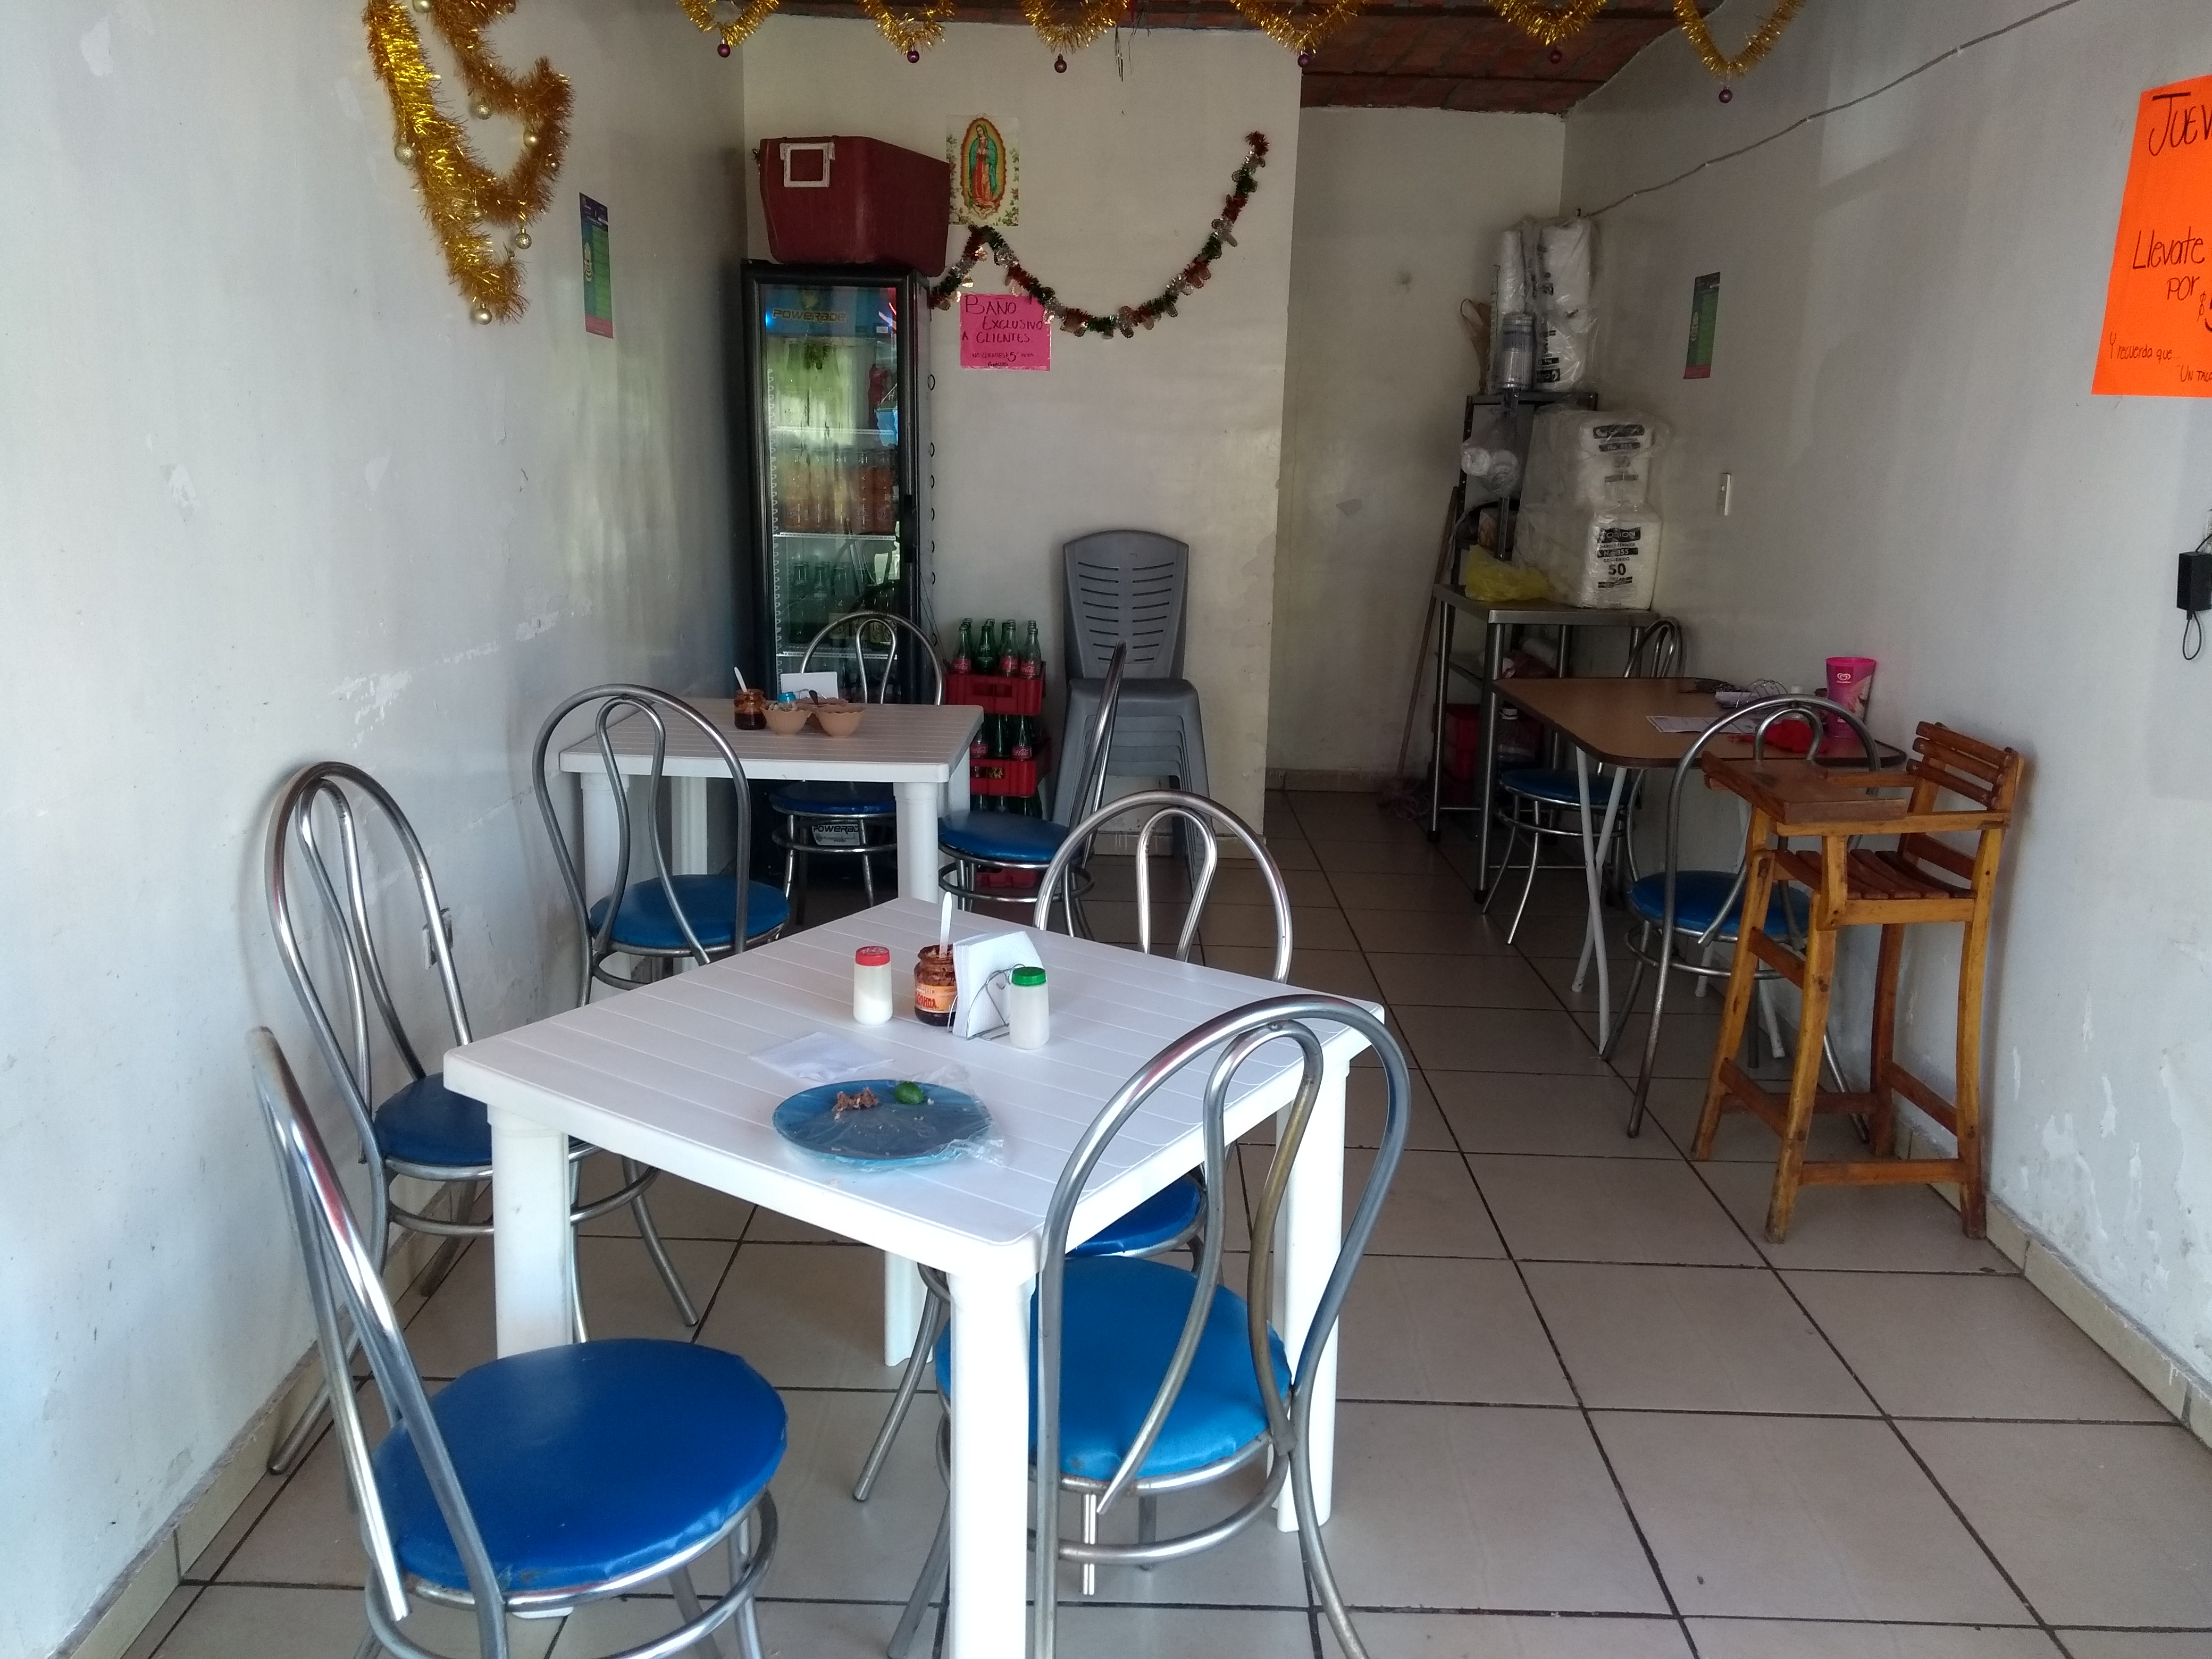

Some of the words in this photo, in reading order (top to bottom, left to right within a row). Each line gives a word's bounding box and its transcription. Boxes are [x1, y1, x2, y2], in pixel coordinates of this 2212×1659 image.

[2133, 226, 2205, 269] Llevate
[965, 295, 1017, 316] BAÑO
[773, 307, 847, 323] POWERADE
[982, 315, 1043, 331] EXCLUSIVO
[962, 331, 969, 341] A
[976, 332, 1030, 343] CLIENTES
[2109, 332, 2116, 359] Y
[2117, 344, 2152, 359] recuerda
[1608, 563, 1626, 576] 50
[813, 825, 859, 834] POWERAD
